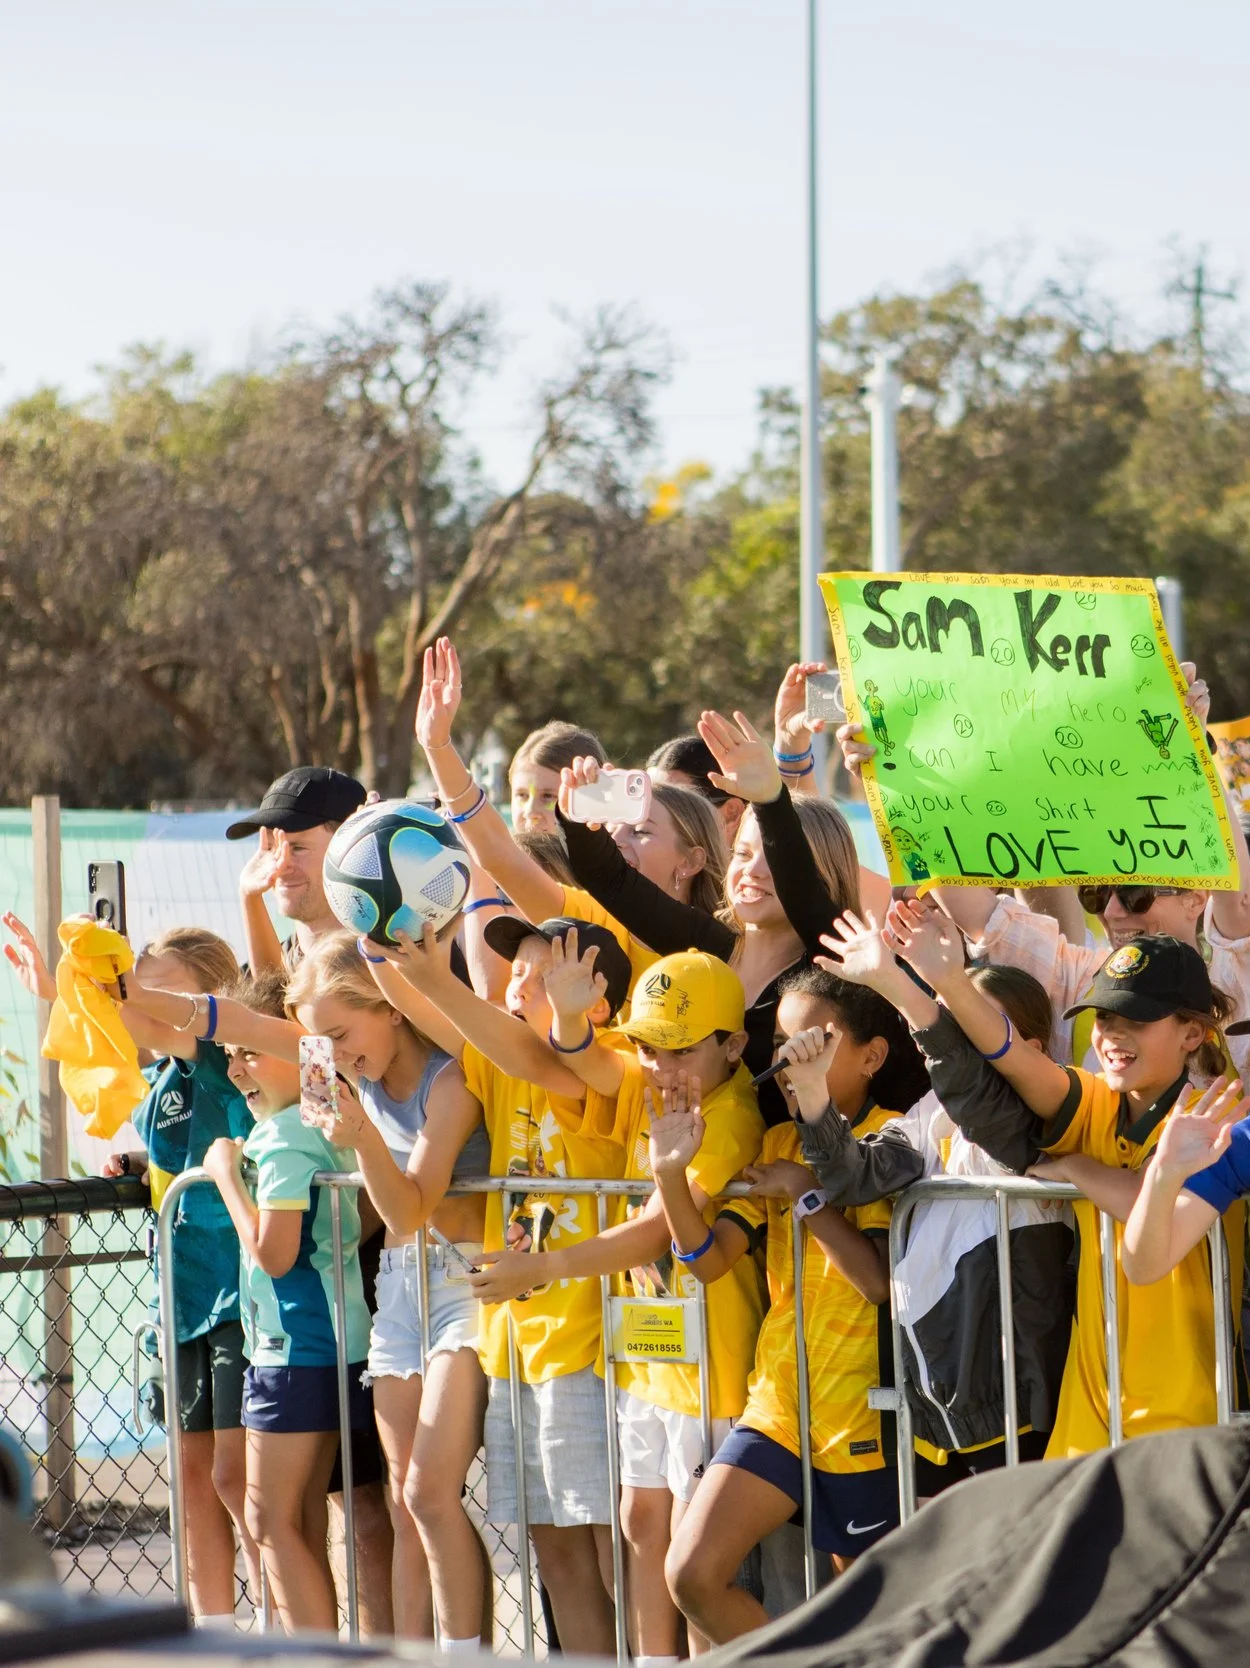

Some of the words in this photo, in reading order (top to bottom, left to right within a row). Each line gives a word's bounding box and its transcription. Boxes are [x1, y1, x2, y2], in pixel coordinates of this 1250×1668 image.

[862, 580, 985, 658] Sam
[1013, 589, 1112, 679] Kerr
[1066, 690, 1127, 723] hero
[984, 749, 1003, 772] I
[1042, 748, 1129, 777] have
[901, 794, 973, 824] your
[1136, 794, 1187, 831] I
[943, 826, 1089, 878] LOVE
[1107, 828, 1194, 875] you
[627, 1342, 682, 1353] 0472618555
